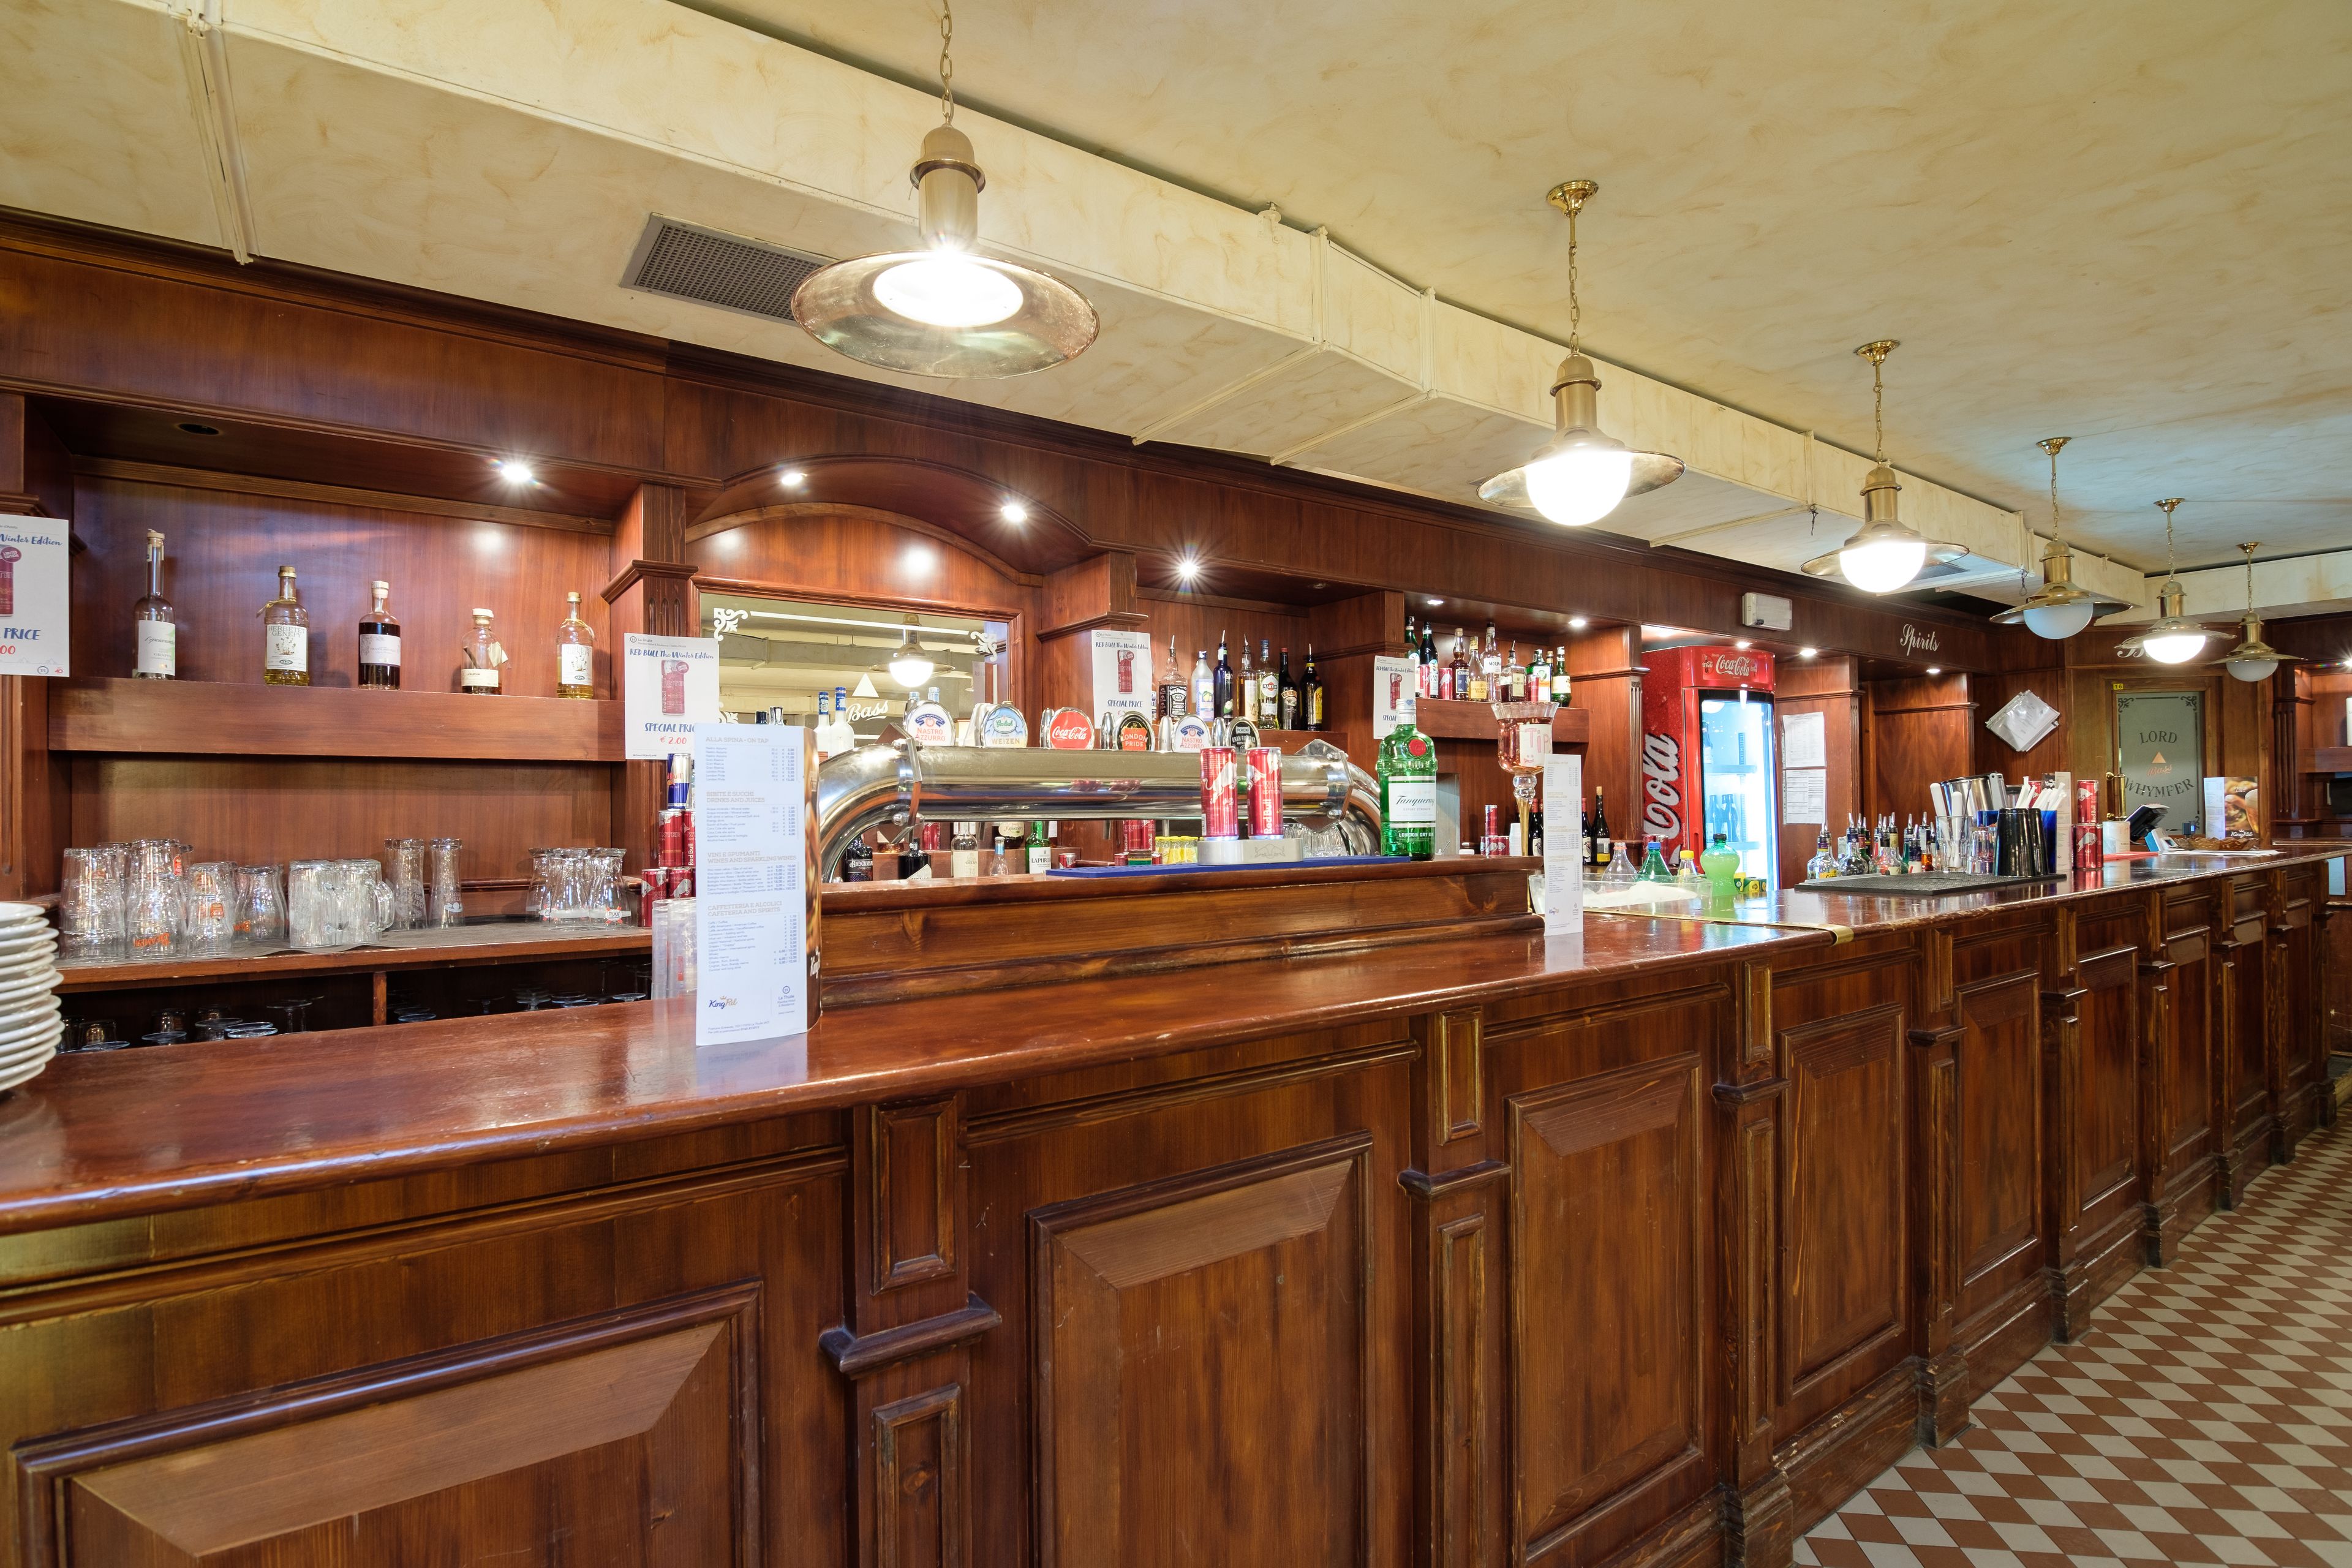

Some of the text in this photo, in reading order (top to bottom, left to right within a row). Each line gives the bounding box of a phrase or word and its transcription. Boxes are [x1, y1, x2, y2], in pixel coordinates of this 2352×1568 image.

[32, 536, 62, 546] Edition
[4, 627, 41, 640] PRICE
[1900, 624, 1940, 656] Spirits
[0, 645, 16, 655] 00
[1716, 654, 1750, 677] Coca-Cola
[846, 700, 889, 723] Bass
[645, 722, 695, 733] SPECIAL PRI
[1052, 726, 1088, 741] Coca-Cola
[1121, 733, 1148, 742] LONDON
[2139, 731, 2177, 744] LORD
[2147, 764, 2172, 777] Bass
[1263, 780, 1282, 790] WIN
[2125, 778, 2195, 797] WHYMPER
[1263, 799, 1272, 834] Red Bull
